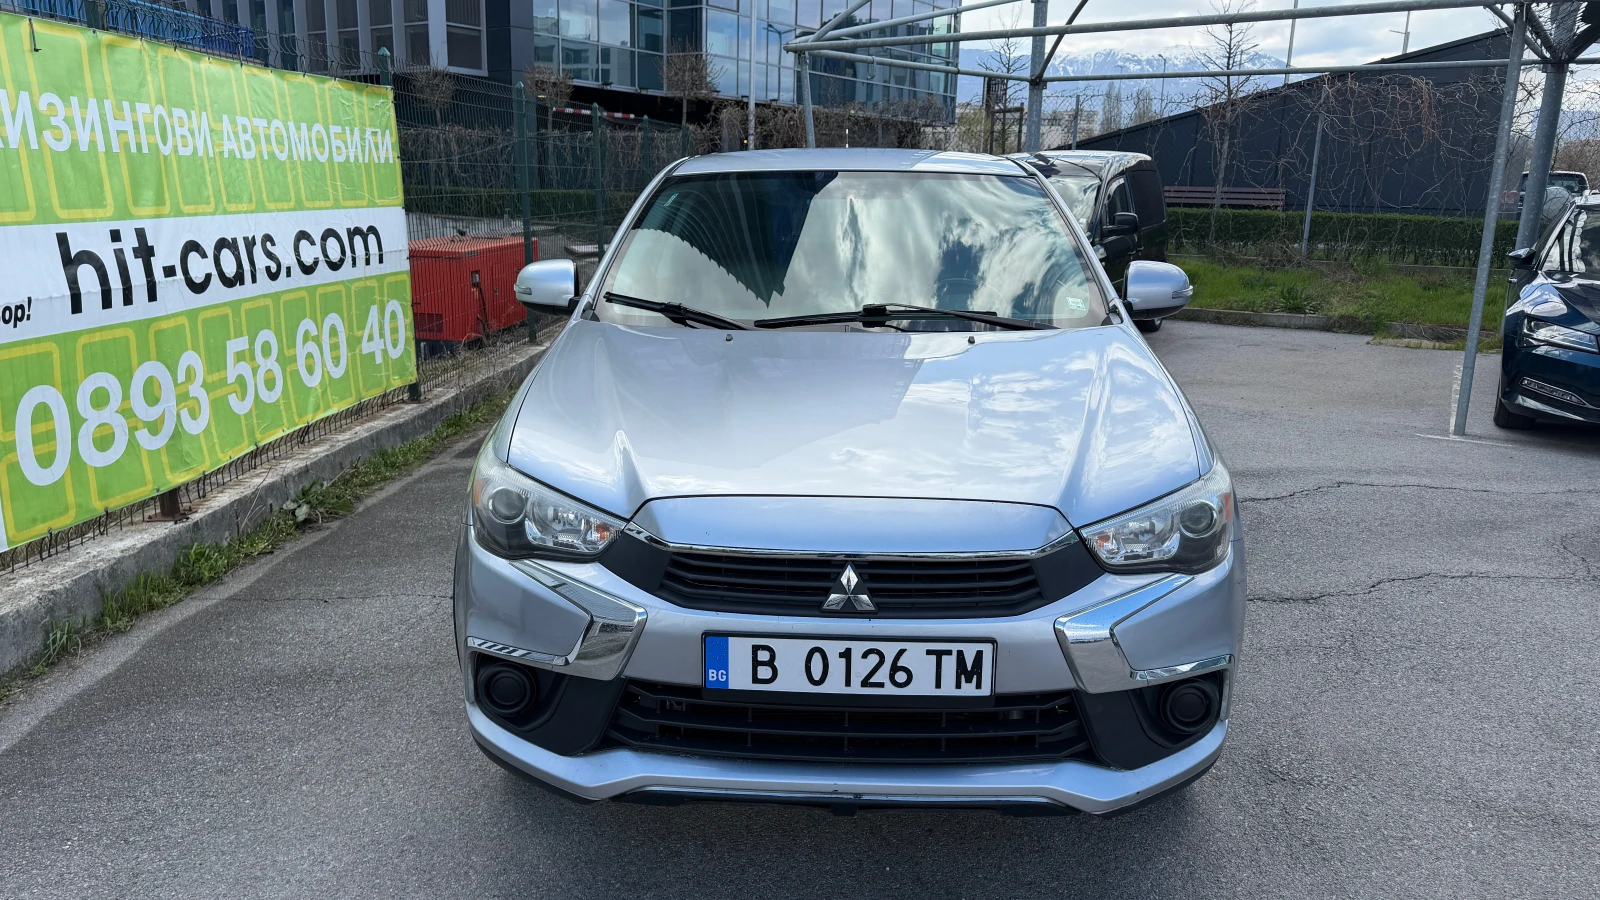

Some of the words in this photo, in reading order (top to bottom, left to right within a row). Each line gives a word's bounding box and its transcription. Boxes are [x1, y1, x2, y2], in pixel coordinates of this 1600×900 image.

[0, 88, 214, 157] ИЗИНГОВИ
[223, 114, 394, 164] АВТОМОБИЛИ
[56, 224, 384, 315] hit-cars.com
[0, 296, 32, 328] ор!
[15, 350, 210, 486] 0893
[226, 329, 283, 415] 58
[296, 312, 347, 387] 60
[361, 299, 405, 365] 40
[708, 669, 727, 682] BG
[751, 644, 778, 684] B
[804, 646, 913, 688] 0126
[926, 649, 984, 690] TM
